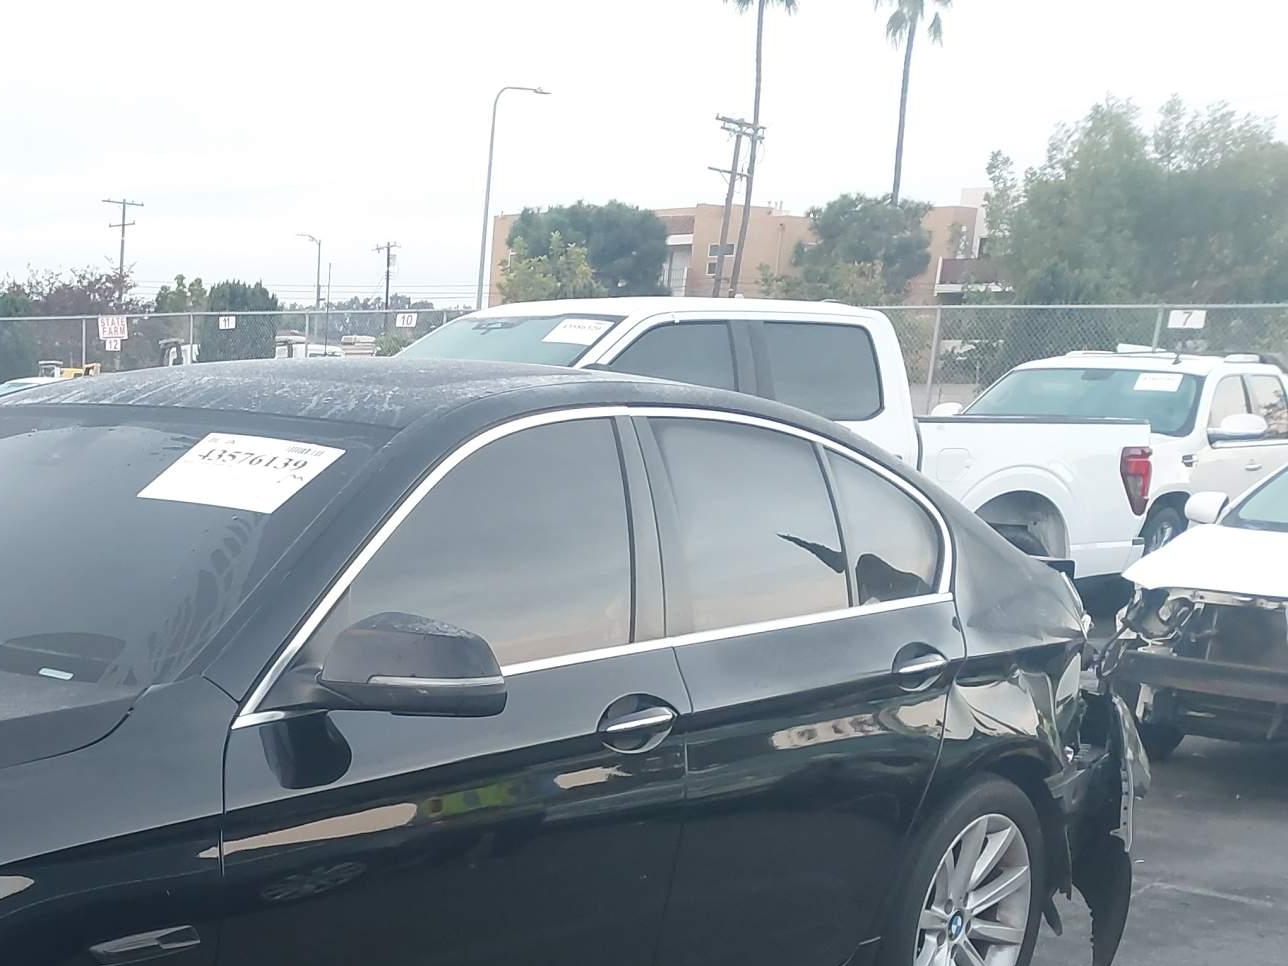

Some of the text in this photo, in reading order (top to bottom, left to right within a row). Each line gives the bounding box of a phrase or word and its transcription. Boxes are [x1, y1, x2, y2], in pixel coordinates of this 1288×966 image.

[100, 318, 126, 327] STATE
[401, 314, 412, 326] 10
[1183, 311, 1193, 327] 7
[102, 326, 126, 336] FARM
[108, 340, 118, 350] 12
[197, 448, 309, 471] 43576139
